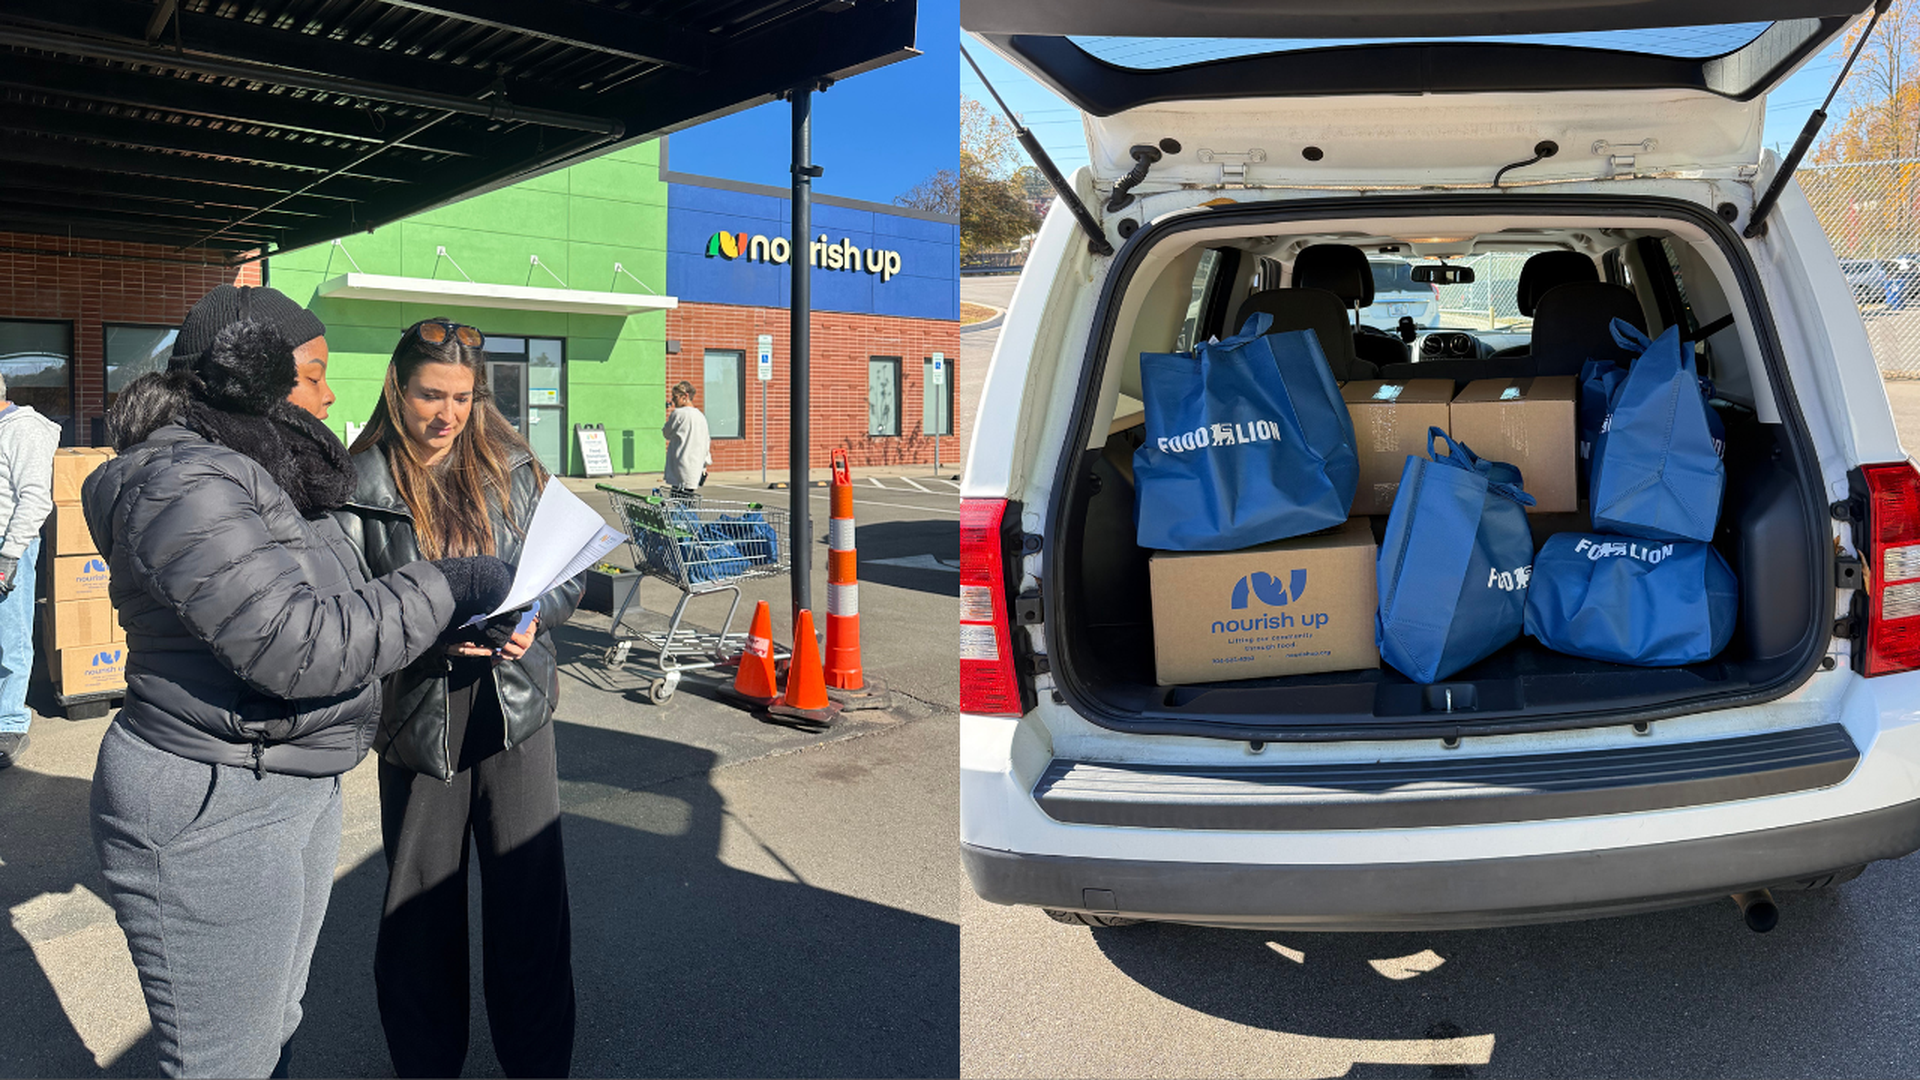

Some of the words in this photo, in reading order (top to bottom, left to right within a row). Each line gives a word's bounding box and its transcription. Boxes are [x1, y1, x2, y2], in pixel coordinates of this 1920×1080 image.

[750, 233, 862, 272] norish
[866, 248, 902, 282] up
[1157, 426, 1210, 454] FOOD
[1235, 419, 1282, 444] LION
[1574, 538, 1603, 561] FO
[1630, 543, 1674, 564] LION
[1211, 612, 1294, 634] nourish
[1301, 612, 1329, 629] up
